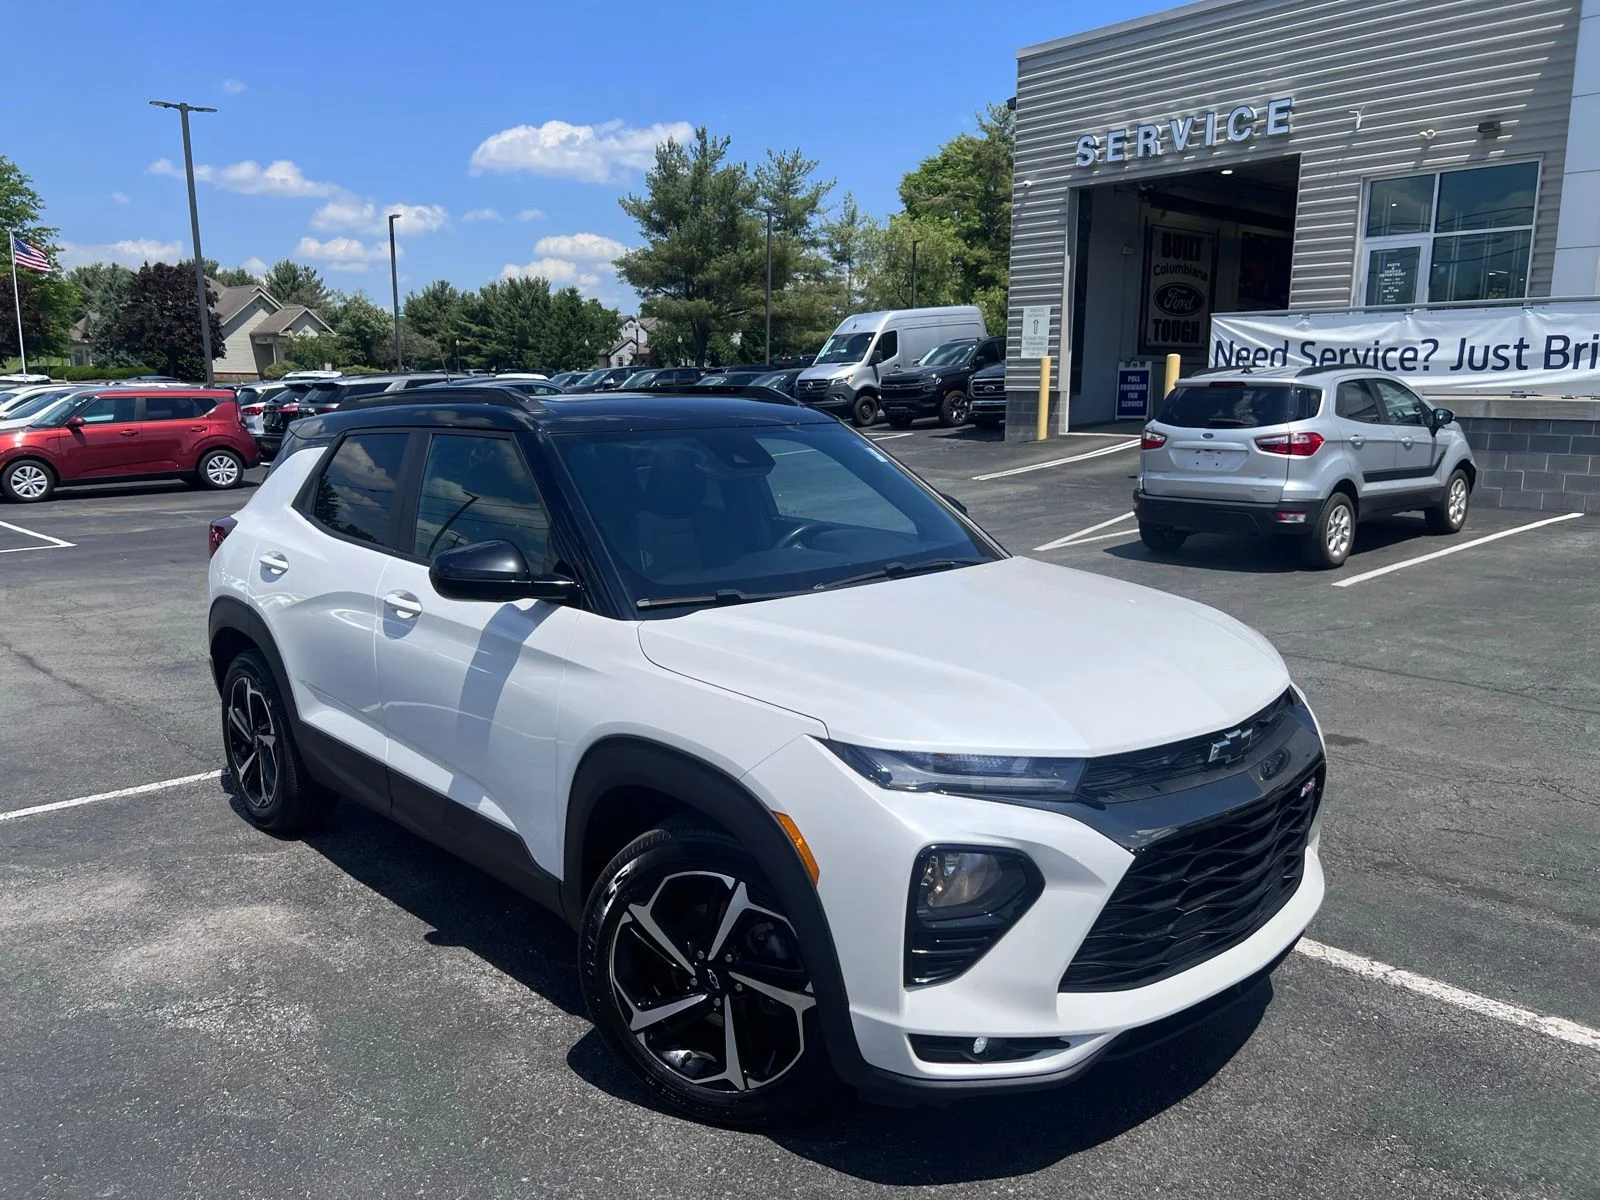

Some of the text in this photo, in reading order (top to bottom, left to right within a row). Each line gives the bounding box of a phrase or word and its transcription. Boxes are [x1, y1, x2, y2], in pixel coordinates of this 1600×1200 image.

[1075, 97, 1294, 167] SERVICE
[1161, 231, 1203, 261] BUILT
[1153, 262, 1208, 281] Columbiana
[1164, 287, 1196, 311] Ford
[1153, 318, 1200, 343] TOUGH
[1214, 334, 1600, 371] Need Service? Just Bri
[1121, 400, 1144, 408] SERVICE
